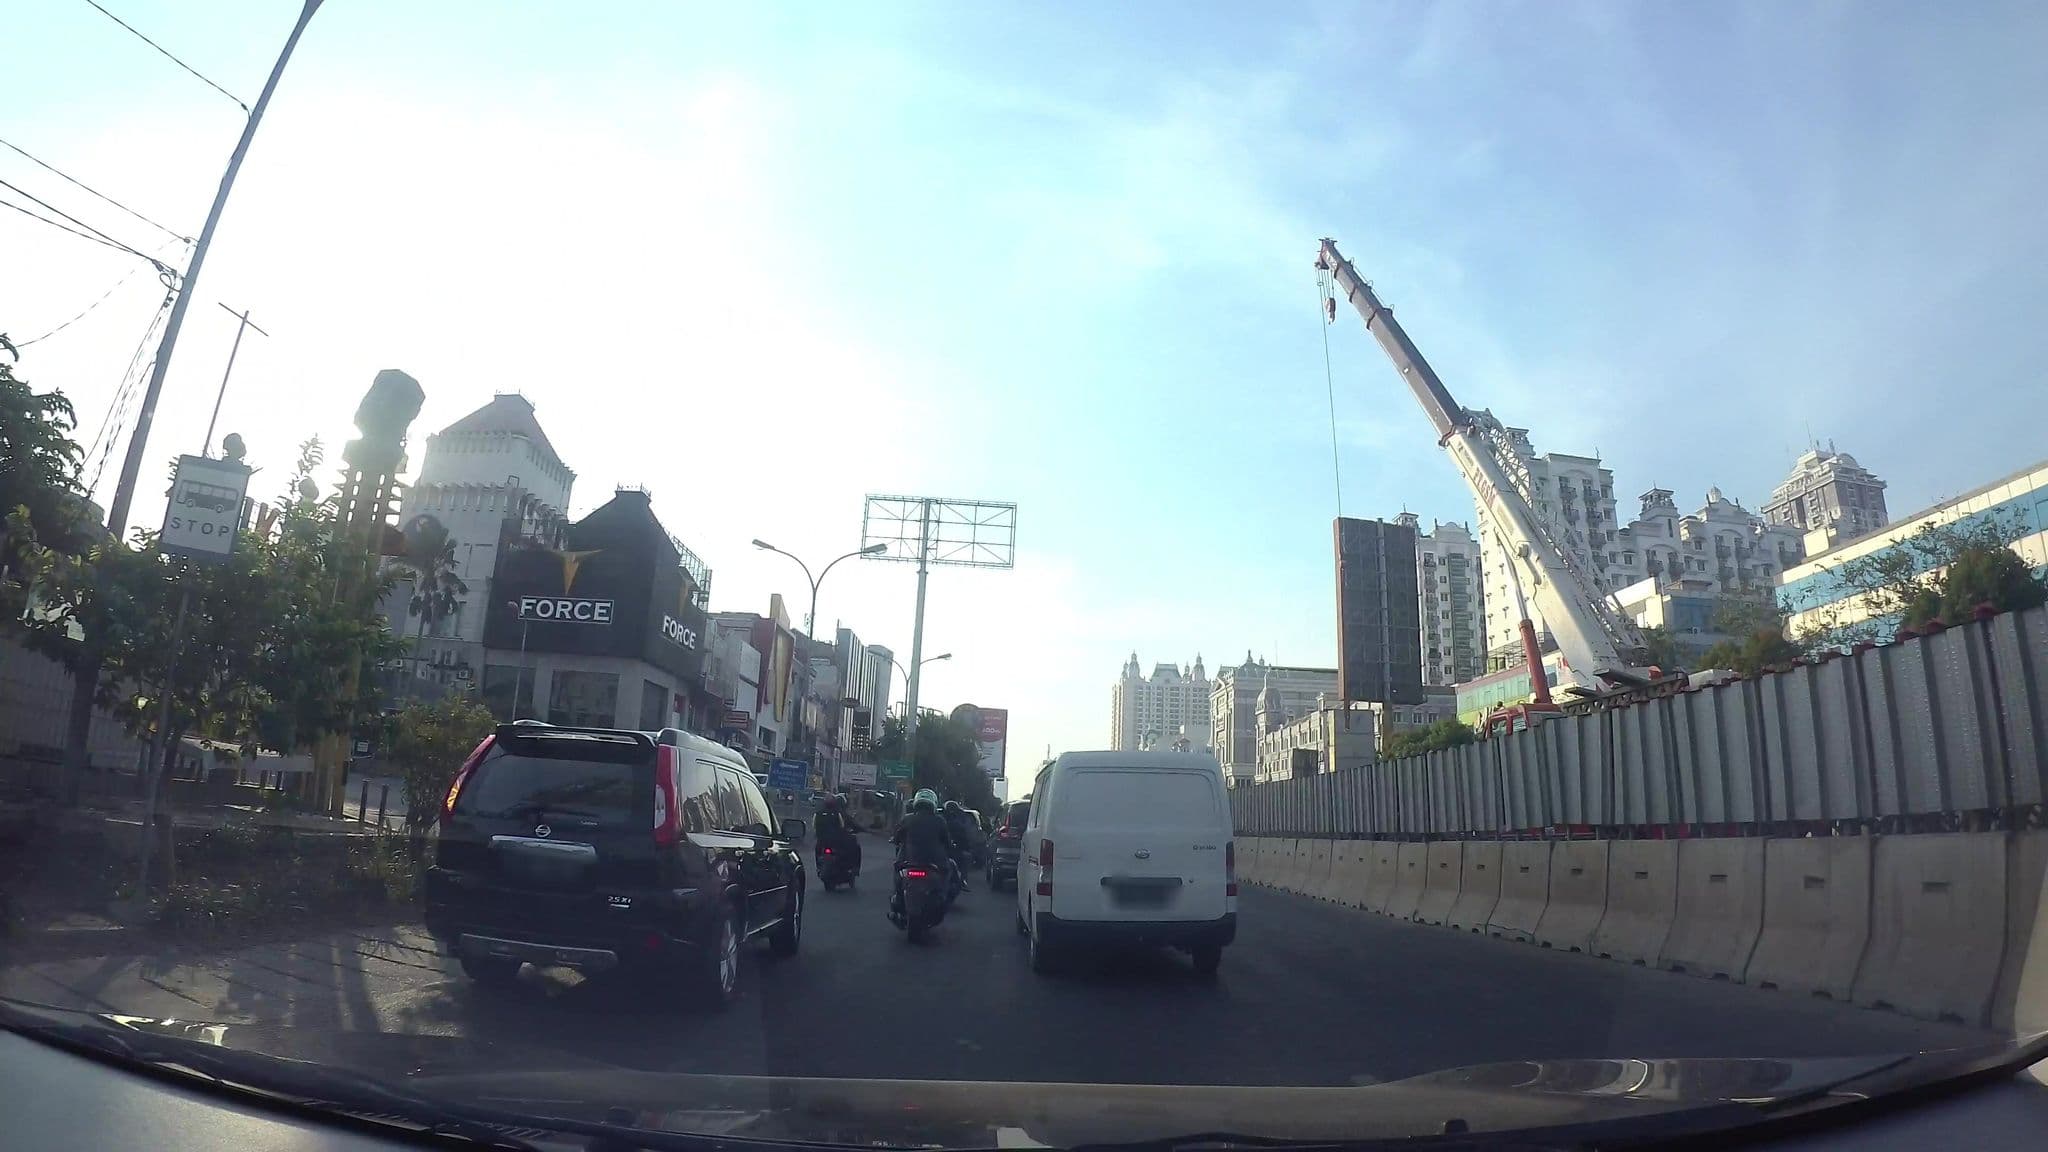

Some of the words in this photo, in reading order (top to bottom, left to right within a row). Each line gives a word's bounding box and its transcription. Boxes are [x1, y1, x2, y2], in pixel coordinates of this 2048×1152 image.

[171, 516, 230, 536] STOP
[520, 598, 611, 621] FORCE
[662, 615, 697, 650] FORCE
